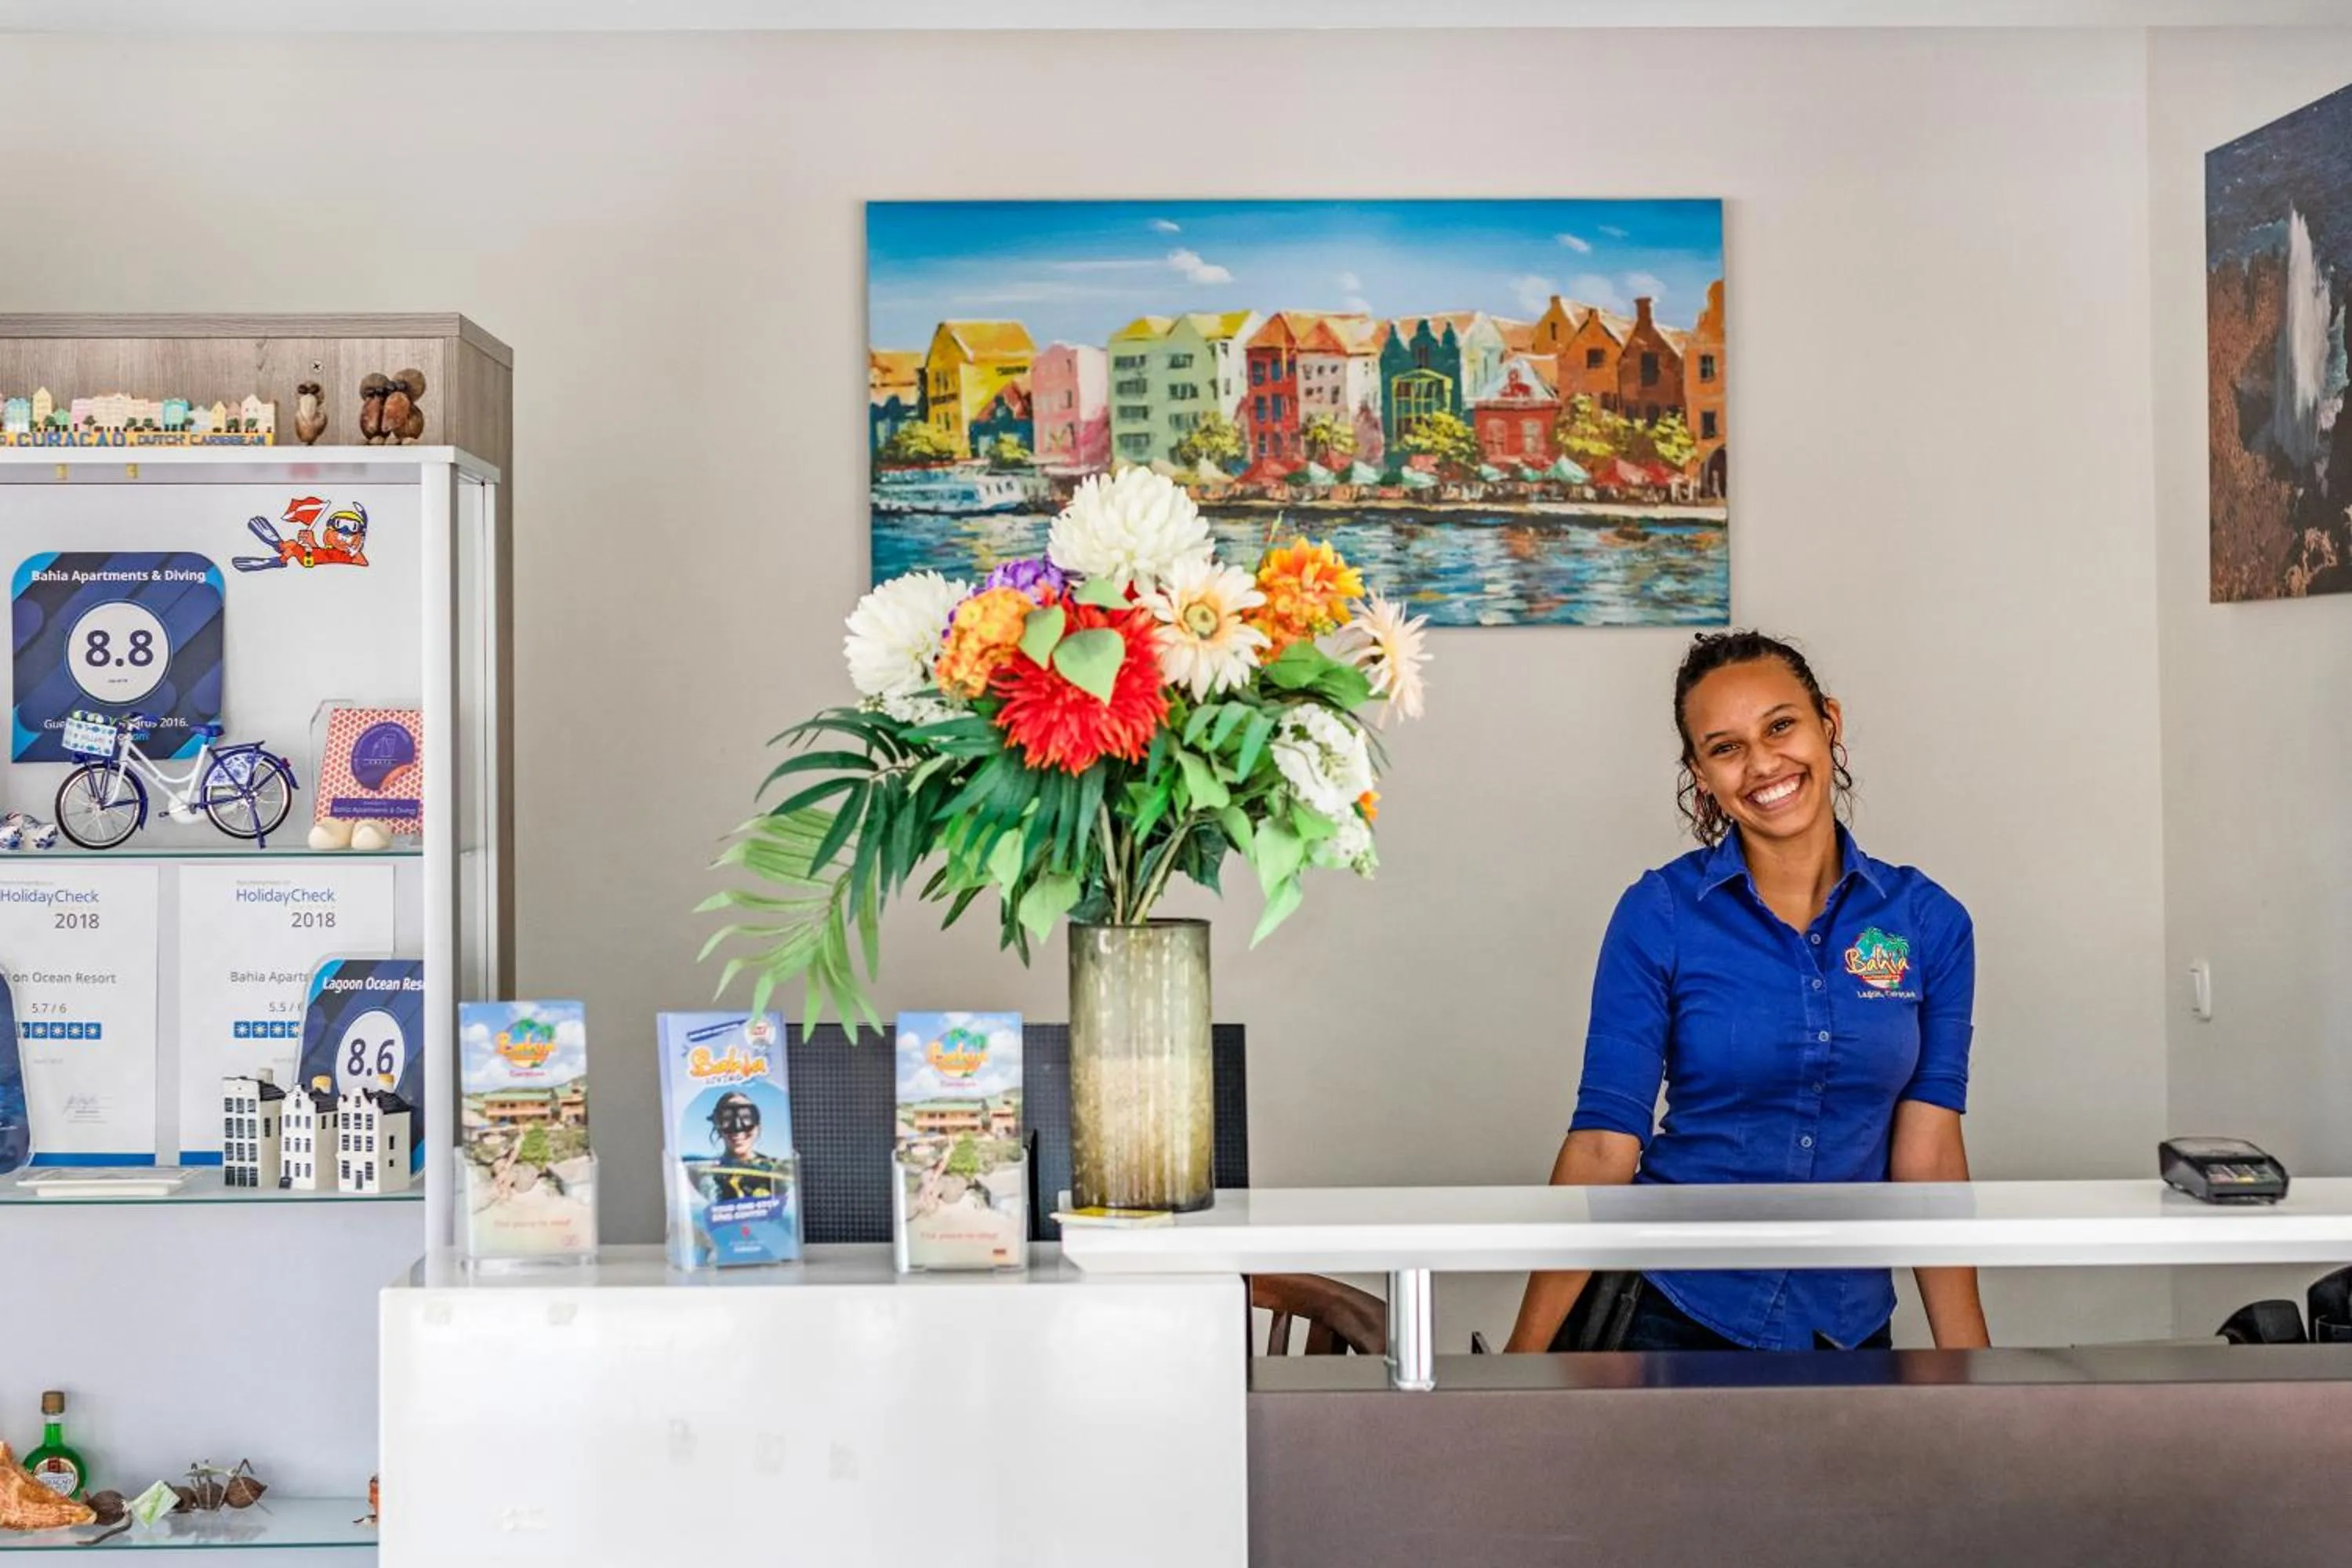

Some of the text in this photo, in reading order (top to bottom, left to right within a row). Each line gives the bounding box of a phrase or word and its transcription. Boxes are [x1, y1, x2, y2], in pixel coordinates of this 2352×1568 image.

[31, 569, 206, 583] Bahia Apartments & Diving
[85, 630, 154, 667] 8.8
[0, 889, 100, 906] HolidayCheck
[236, 887, 336, 906] HolidayCheck
[54, 913, 100, 929] 2018
[291, 911, 336, 928] 2018
[32, 972, 71, 983] Ocean
[76, 972, 117, 984] Resort
[230, 971, 266, 982] Bahia
[322, 976, 424, 993] Lagoon Ocean Res
[31, 1003, 49, 1014] 5.7
[59, 1003, 67, 1014] 6
[269, 1002, 286, 1012] 5.5
[347, 1038, 394, 1076] 8.6
